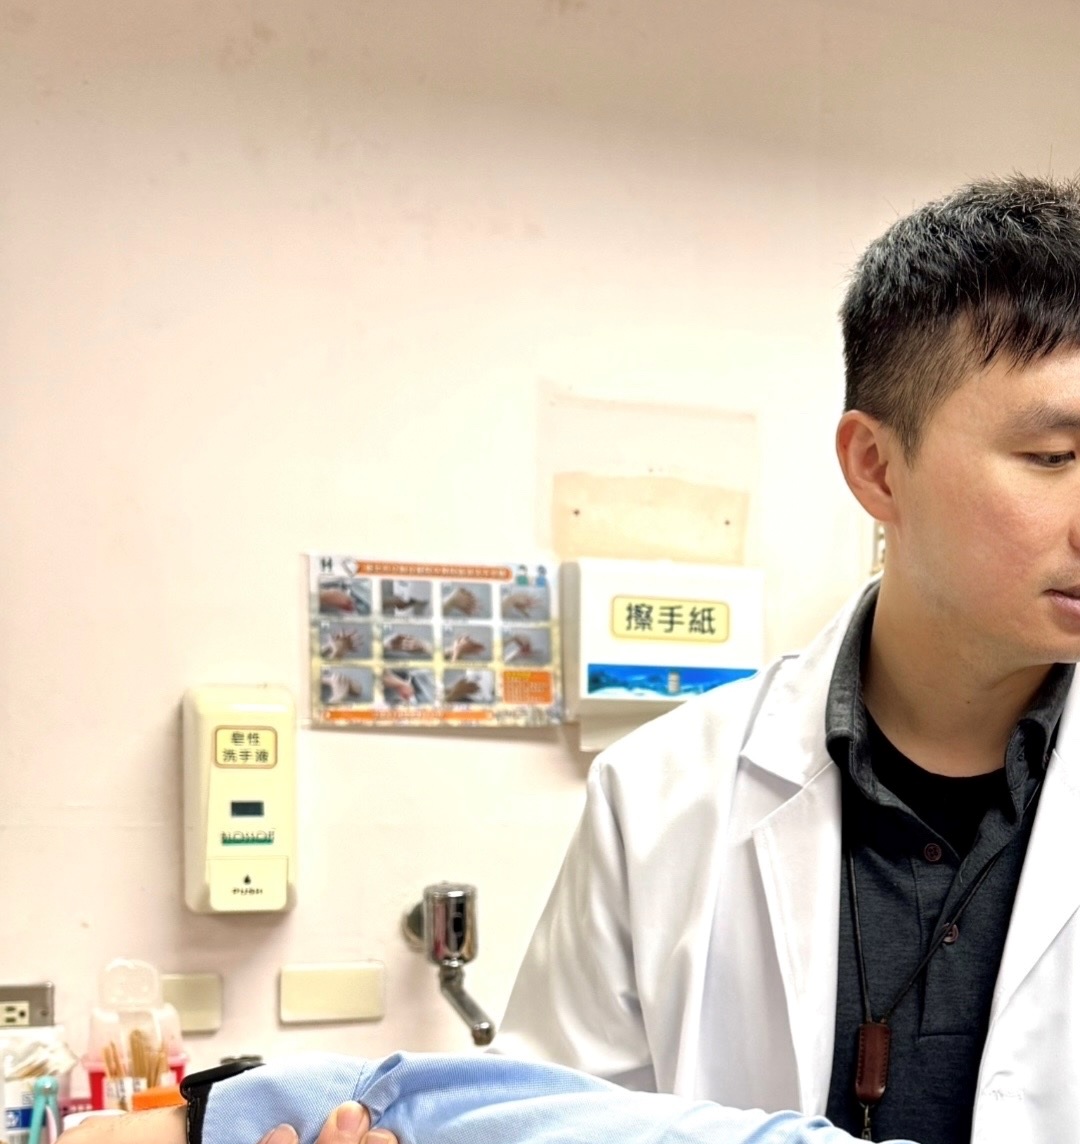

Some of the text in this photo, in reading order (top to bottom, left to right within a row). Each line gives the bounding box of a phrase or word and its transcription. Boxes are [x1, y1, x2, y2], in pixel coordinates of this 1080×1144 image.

[626, 603, 716, 634] 擦手紙
[222, 748, 269, 763] 洗手液
